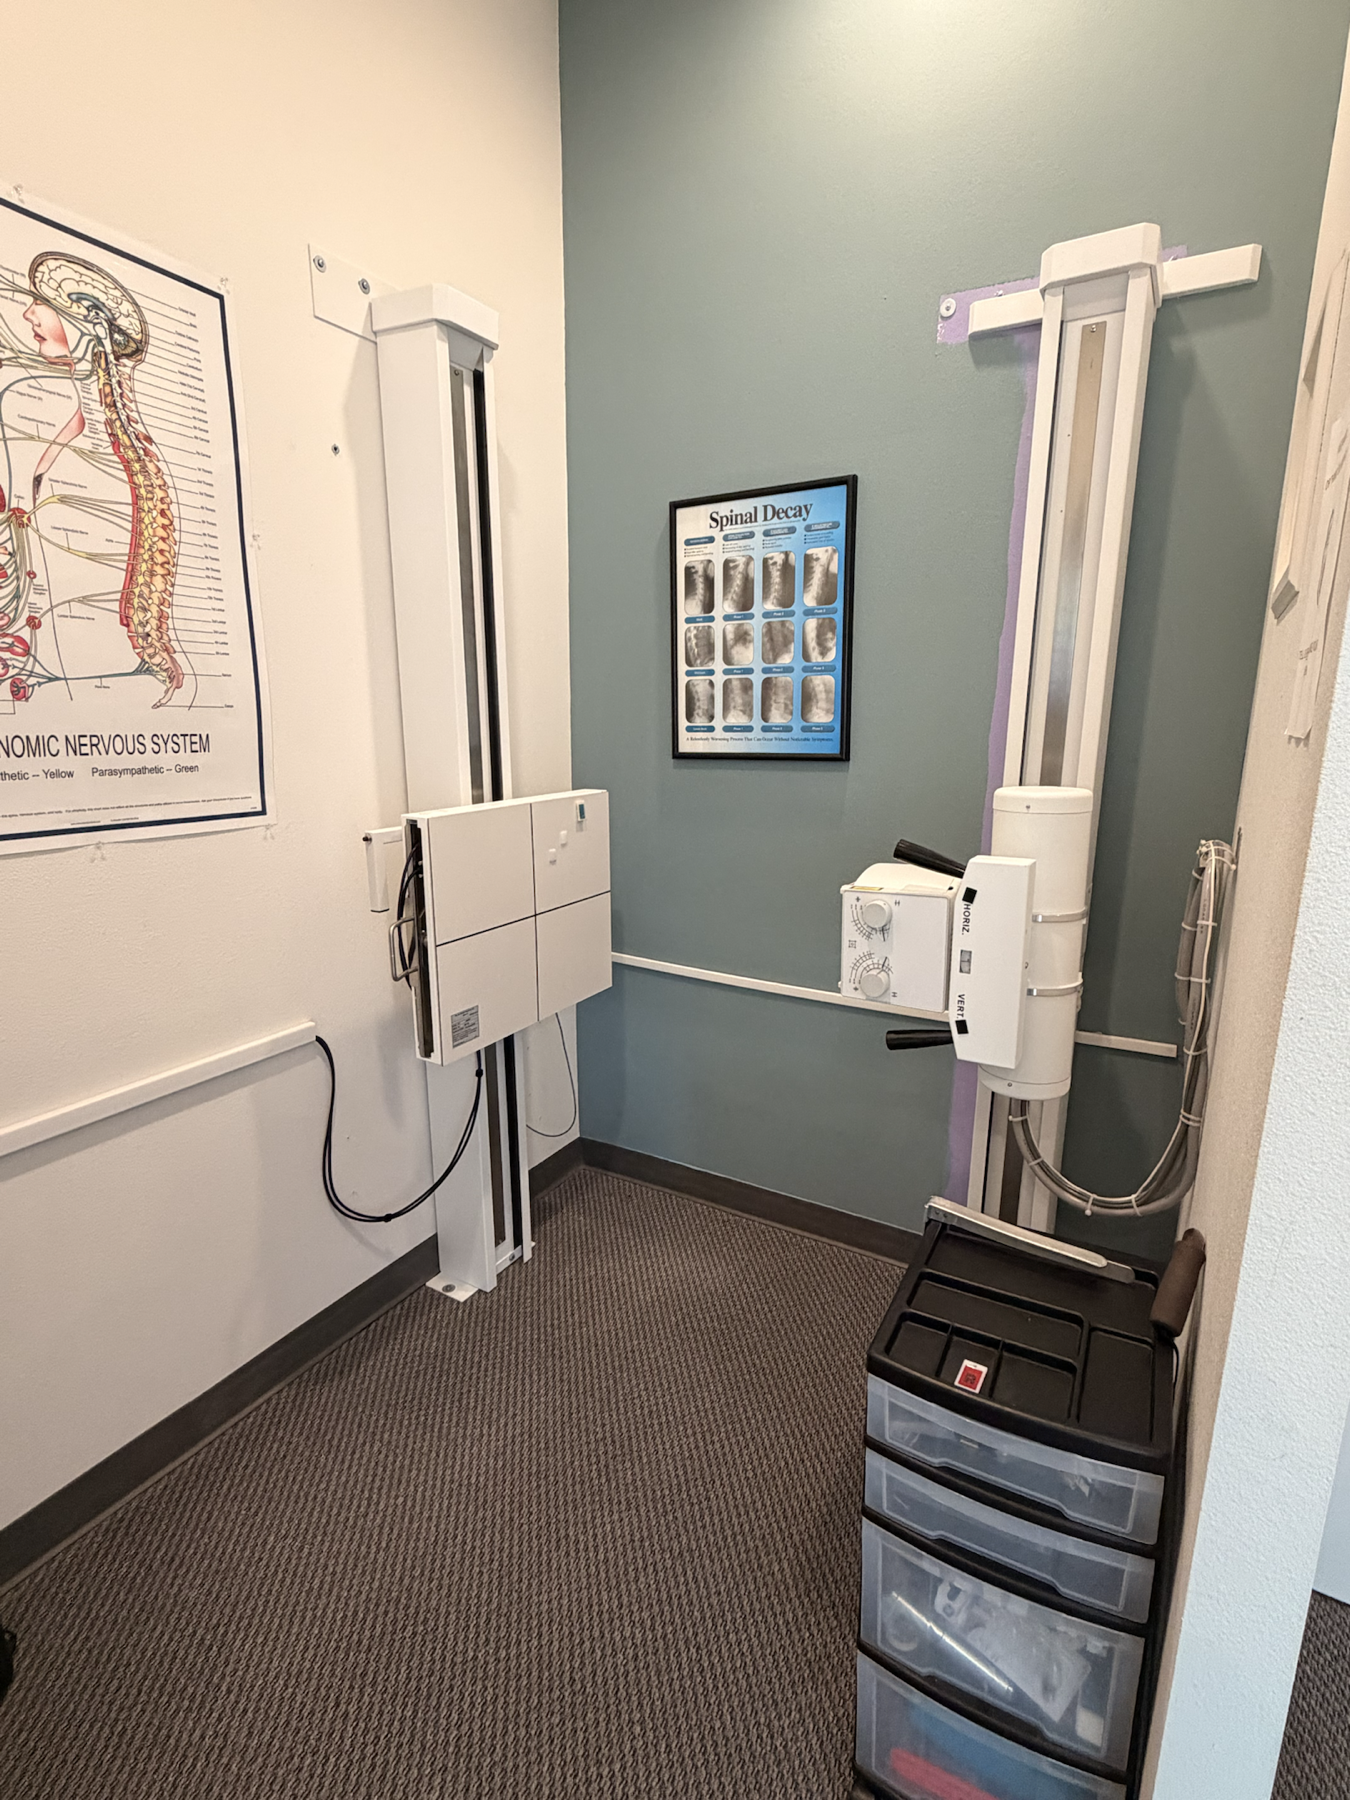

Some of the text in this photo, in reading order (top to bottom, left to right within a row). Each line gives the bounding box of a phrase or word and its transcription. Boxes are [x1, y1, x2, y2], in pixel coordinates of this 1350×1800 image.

[709, 505, 758, 532] Spinal
[762, 503, 814, 522] Decay
[65, 733, 147, 757] NERVOUS
[150, 733, 211, 755] SYSTEM
[42, 768, 75, 780] Yellow
[91, 764, 165, 779] Parasympathetic
[174, 763, 199, 774] Green
[961, 903, 972, 936] HORIZ.
[956, 993, 966, 1020] VERT.
